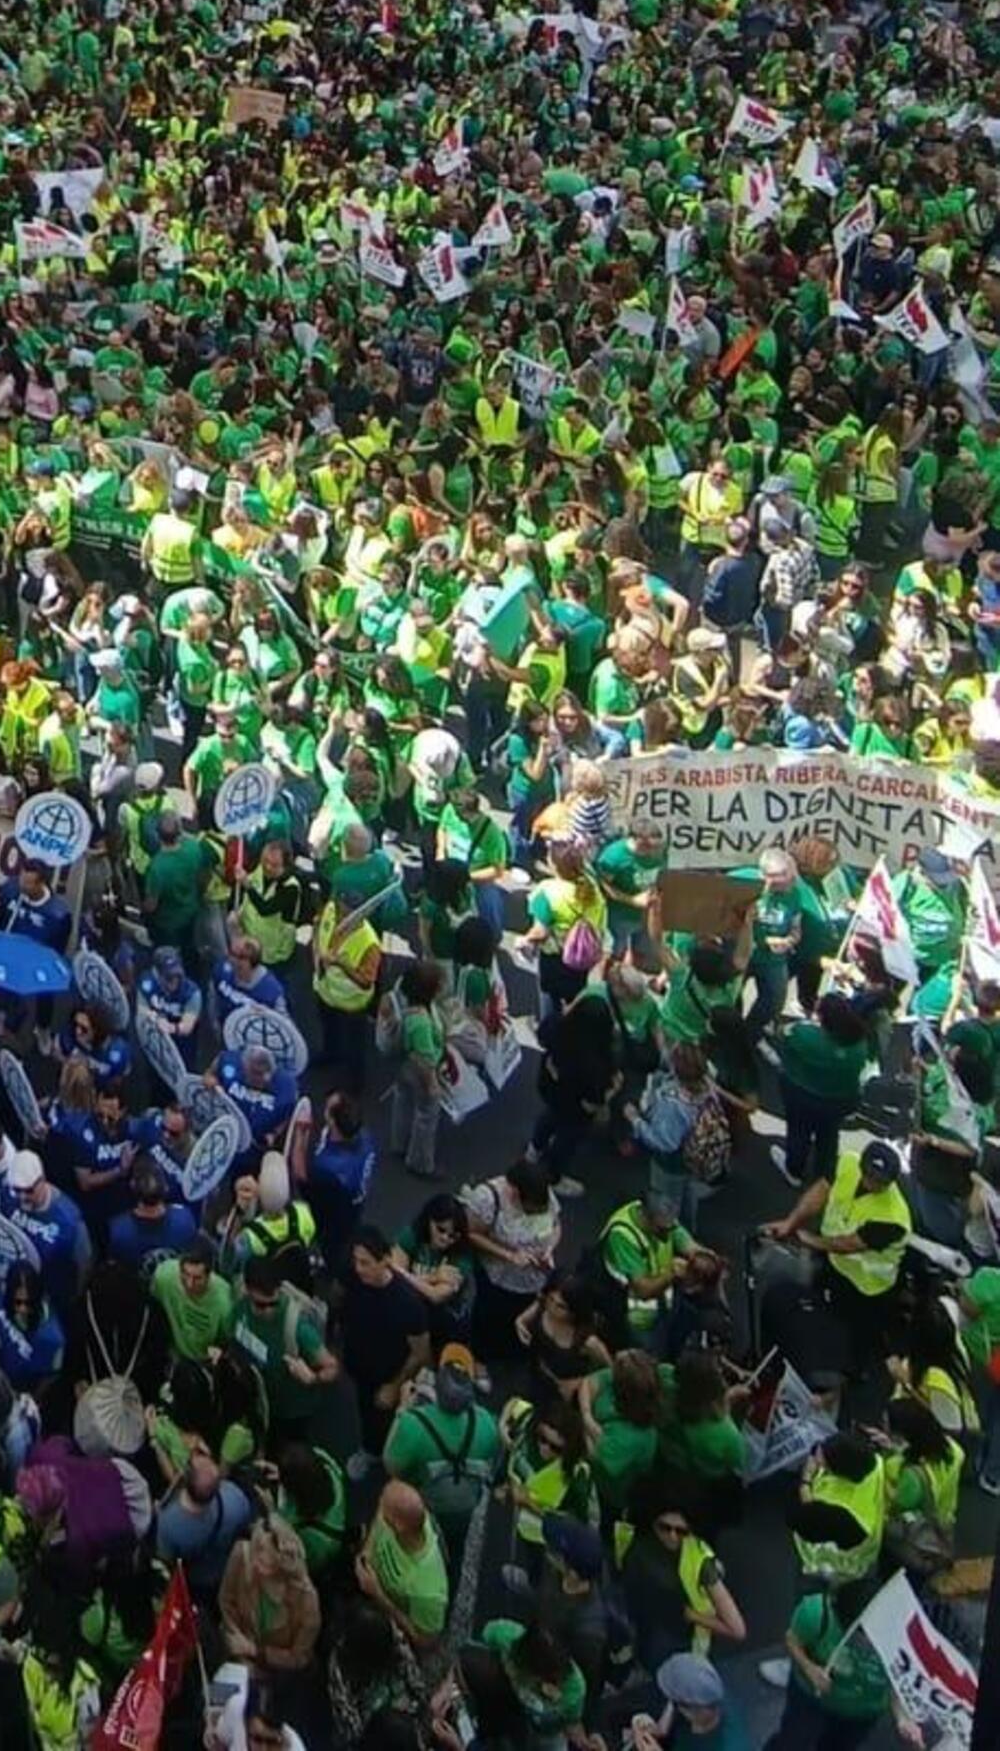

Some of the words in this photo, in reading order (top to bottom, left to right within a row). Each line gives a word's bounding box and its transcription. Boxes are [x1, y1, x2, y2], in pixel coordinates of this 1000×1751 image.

[673, 763, 770, 788] ARABISTA
[632, 788, 691, 817] PER
[708, 791, 748, 822] LA
[765, 786, 956, 846] DIGNITAT
[20, 826, 76, 860] ANPE
